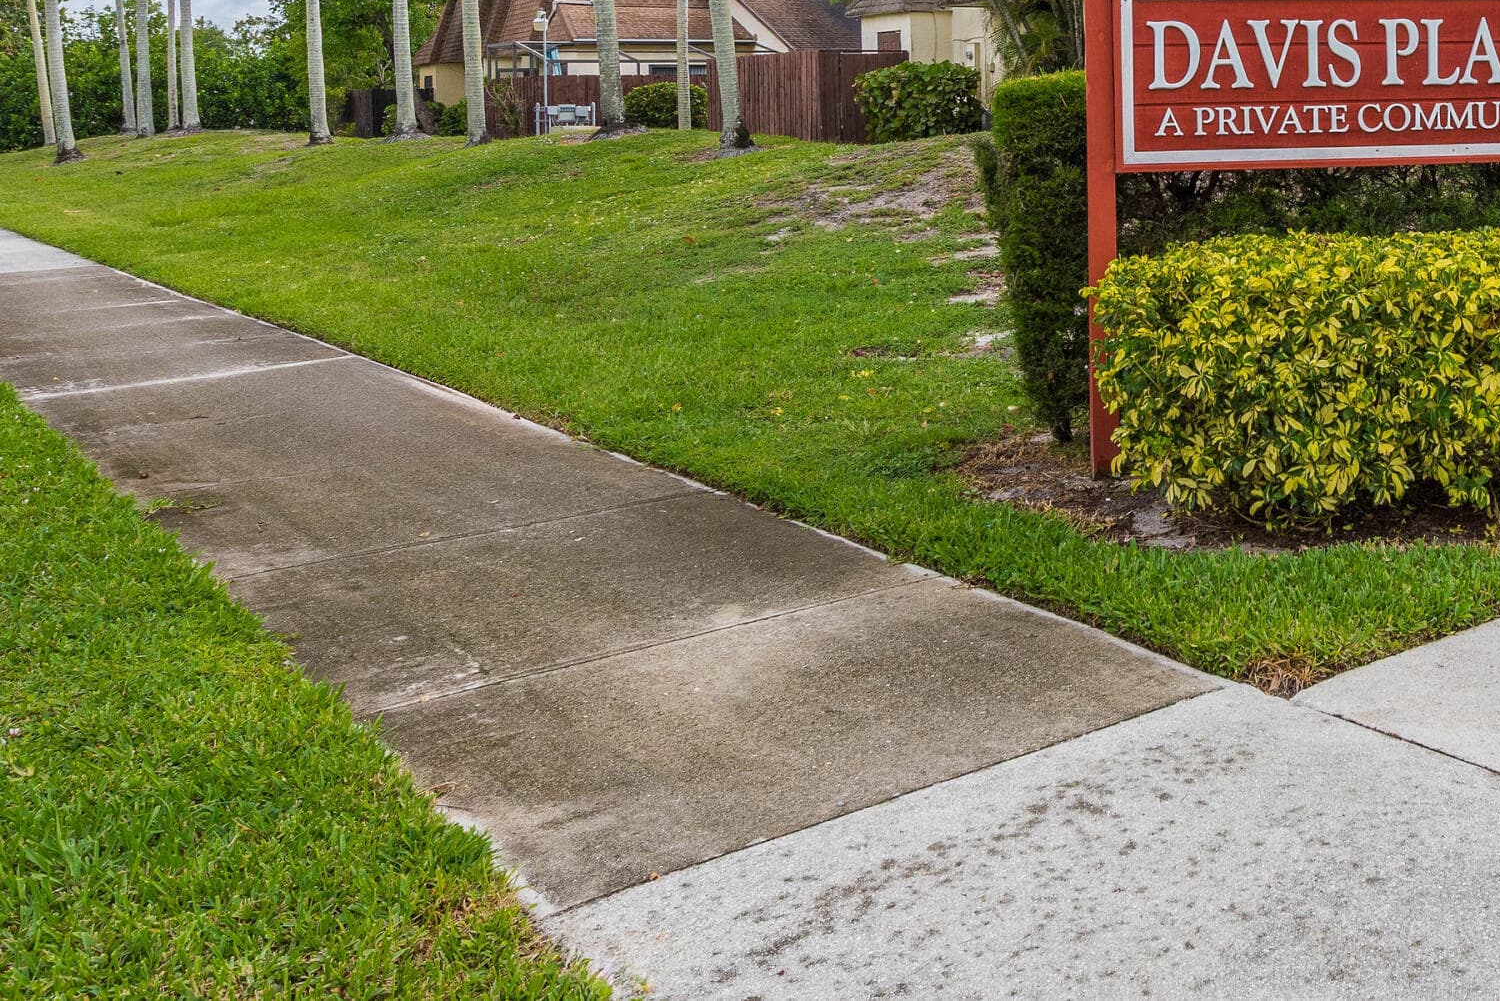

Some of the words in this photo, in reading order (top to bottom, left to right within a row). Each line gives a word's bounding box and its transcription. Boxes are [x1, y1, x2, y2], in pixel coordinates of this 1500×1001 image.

[1146, 18, 1362, 91] DAVIS
[1155, 107, 1184, 137] A
[1194, 105, 1350, 136] PRIVATE
